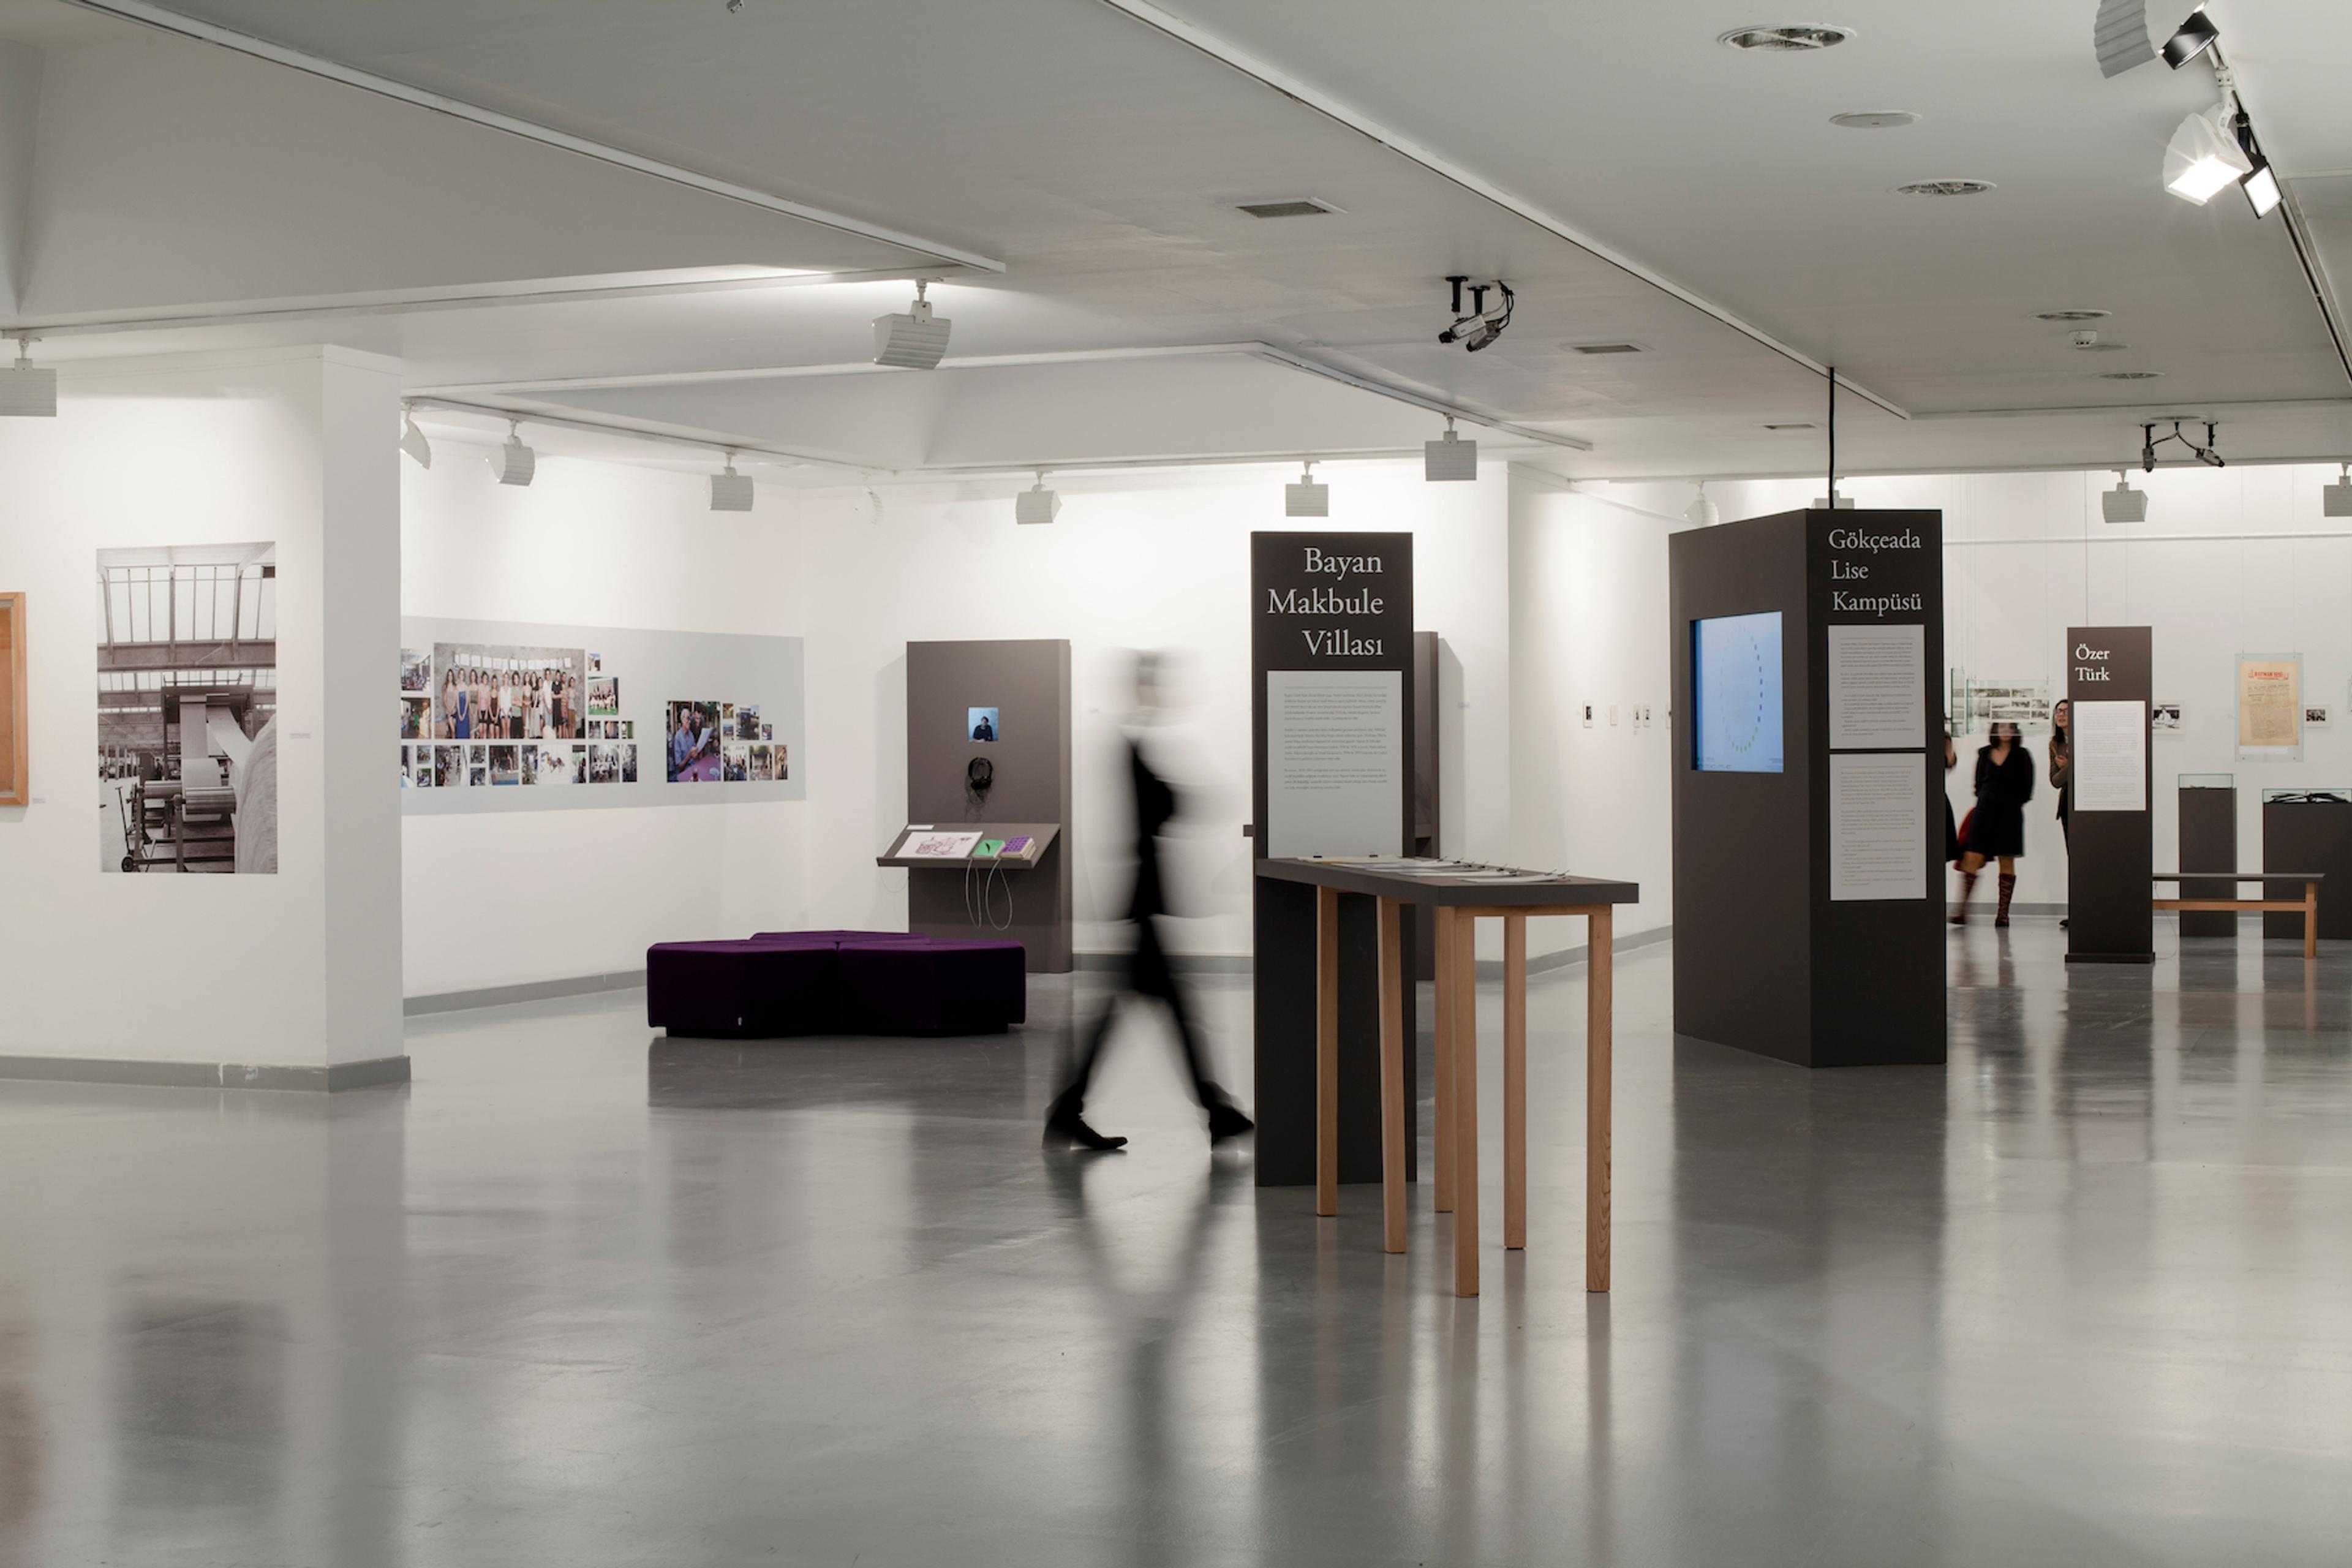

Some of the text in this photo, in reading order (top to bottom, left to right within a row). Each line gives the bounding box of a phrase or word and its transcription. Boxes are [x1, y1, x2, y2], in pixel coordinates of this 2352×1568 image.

[1828, 528, 1921, 554] Gökçeada
[1303, 547, 1384, 581] Bayan
[1831, 560, 1869, 579] Lise
[1267, 587, 1384, 615] Makbule
[1832, 591, 1923, 617] Kampüsü
[1301, 628, 1384, 656] Villası
[2075, 643, 2111, 660] Özer
[2075, 666, 2111, 681] Türk
